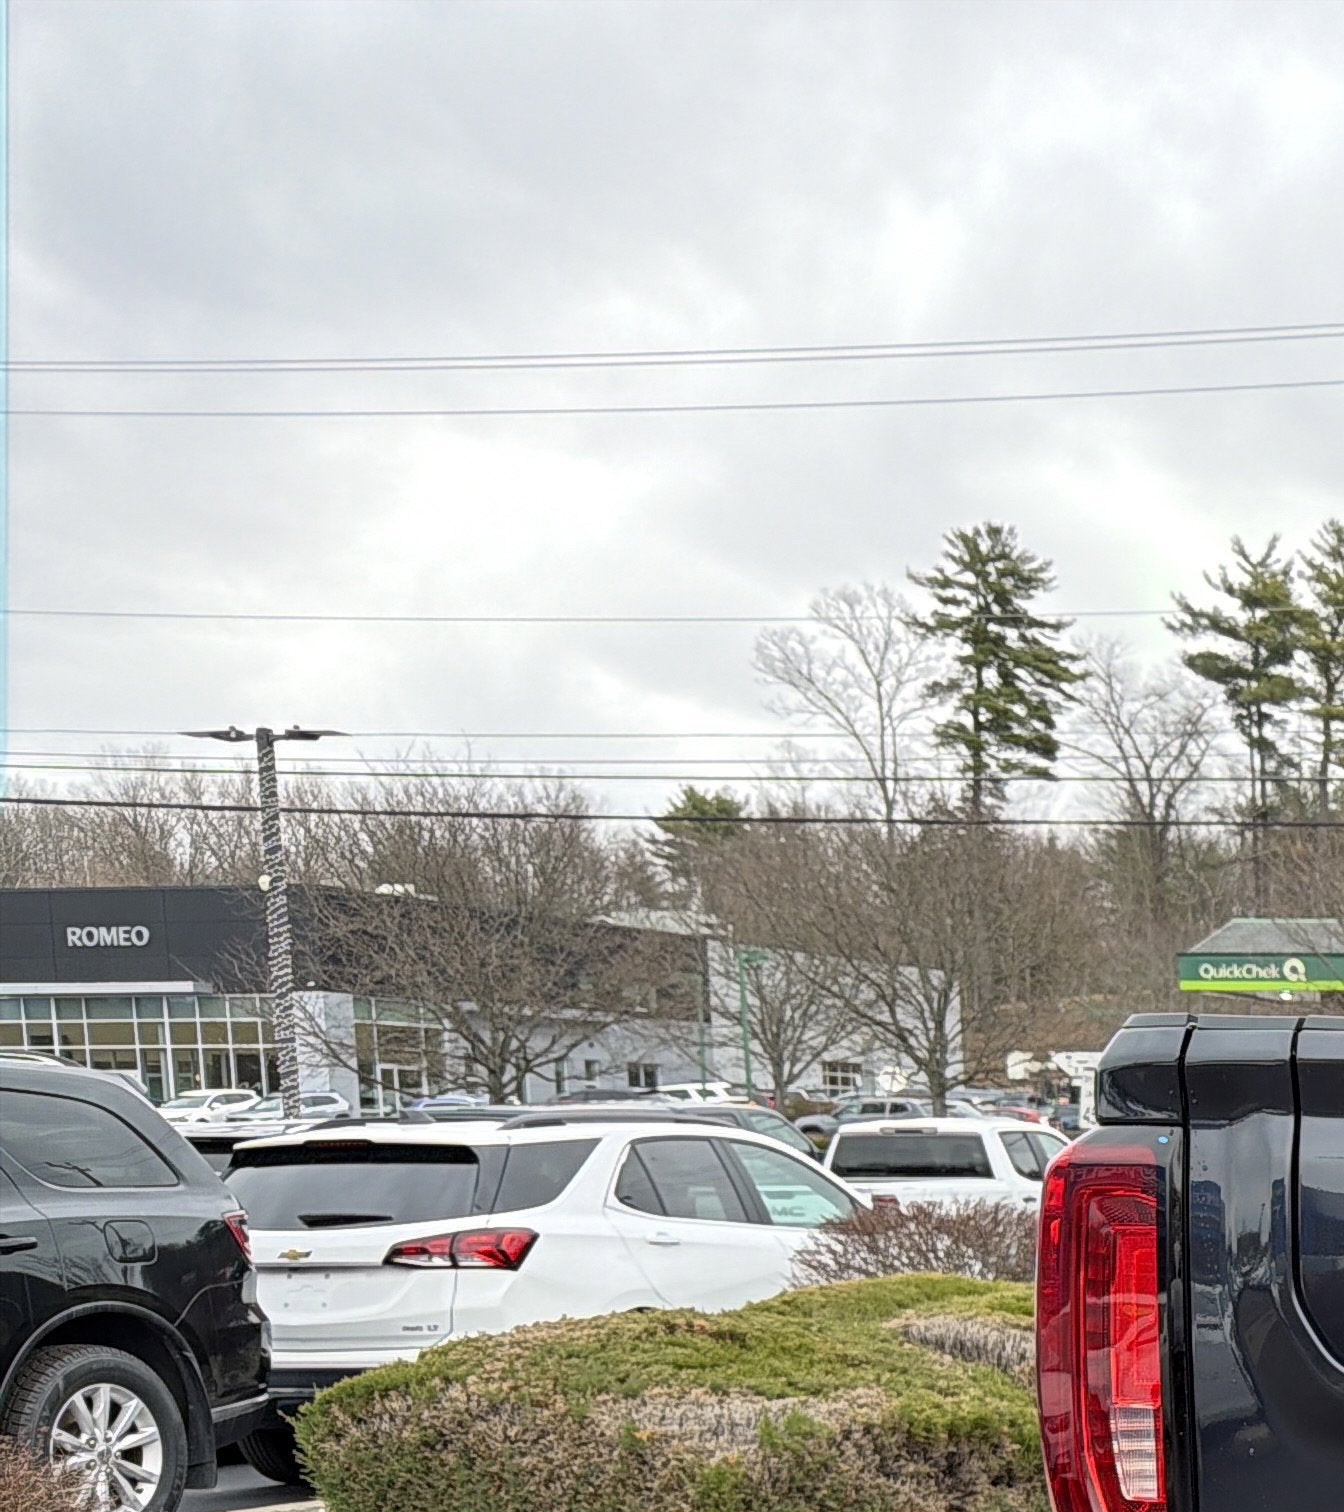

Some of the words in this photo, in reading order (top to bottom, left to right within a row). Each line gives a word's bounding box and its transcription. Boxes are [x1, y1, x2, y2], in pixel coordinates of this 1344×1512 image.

[66, 925, 150, 947] ROMEO
[1199, 962, 1280, 979] QuickChek
[771, 1205, 805, 1217] MC
